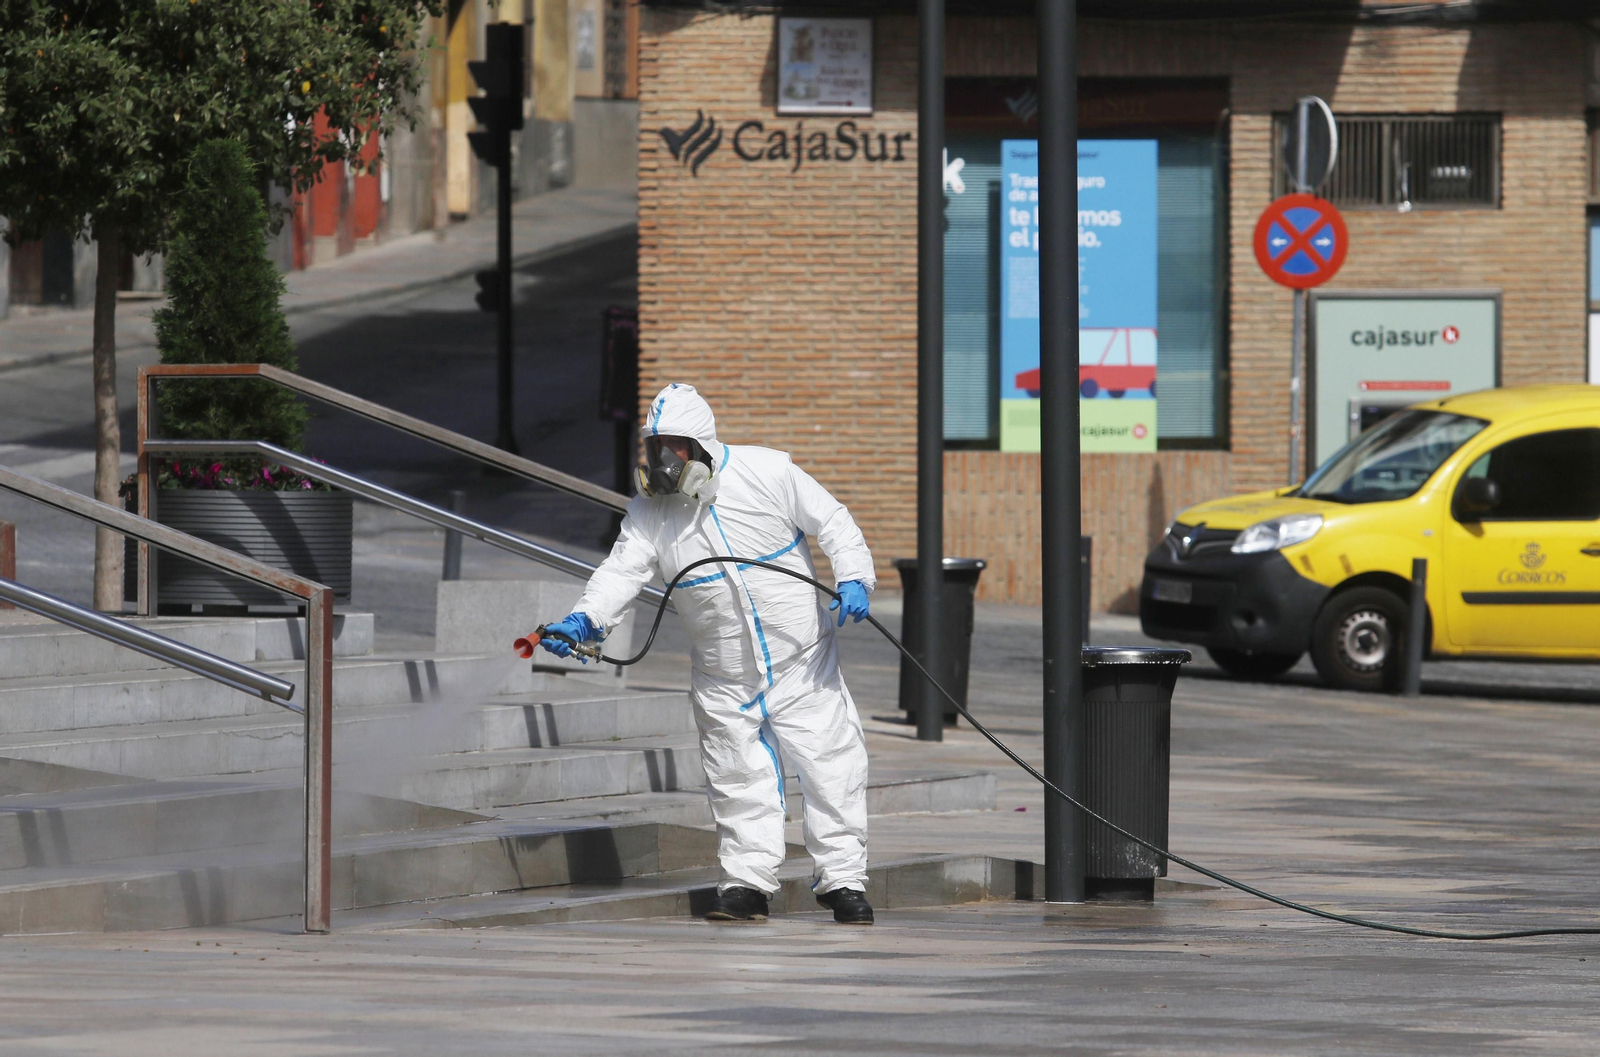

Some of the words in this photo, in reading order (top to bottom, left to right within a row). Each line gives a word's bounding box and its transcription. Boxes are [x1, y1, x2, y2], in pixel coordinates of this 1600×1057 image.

[733, 120, 911, 173] CajaSur
[1008, 189, 1028, 203] de
[1009, 206, 1031, 227] te
[1009, 227, 1031, 248] el
[1350, 324, 1439, 351] cajasur
[1497, 567, 1567, 585] CORREOS
